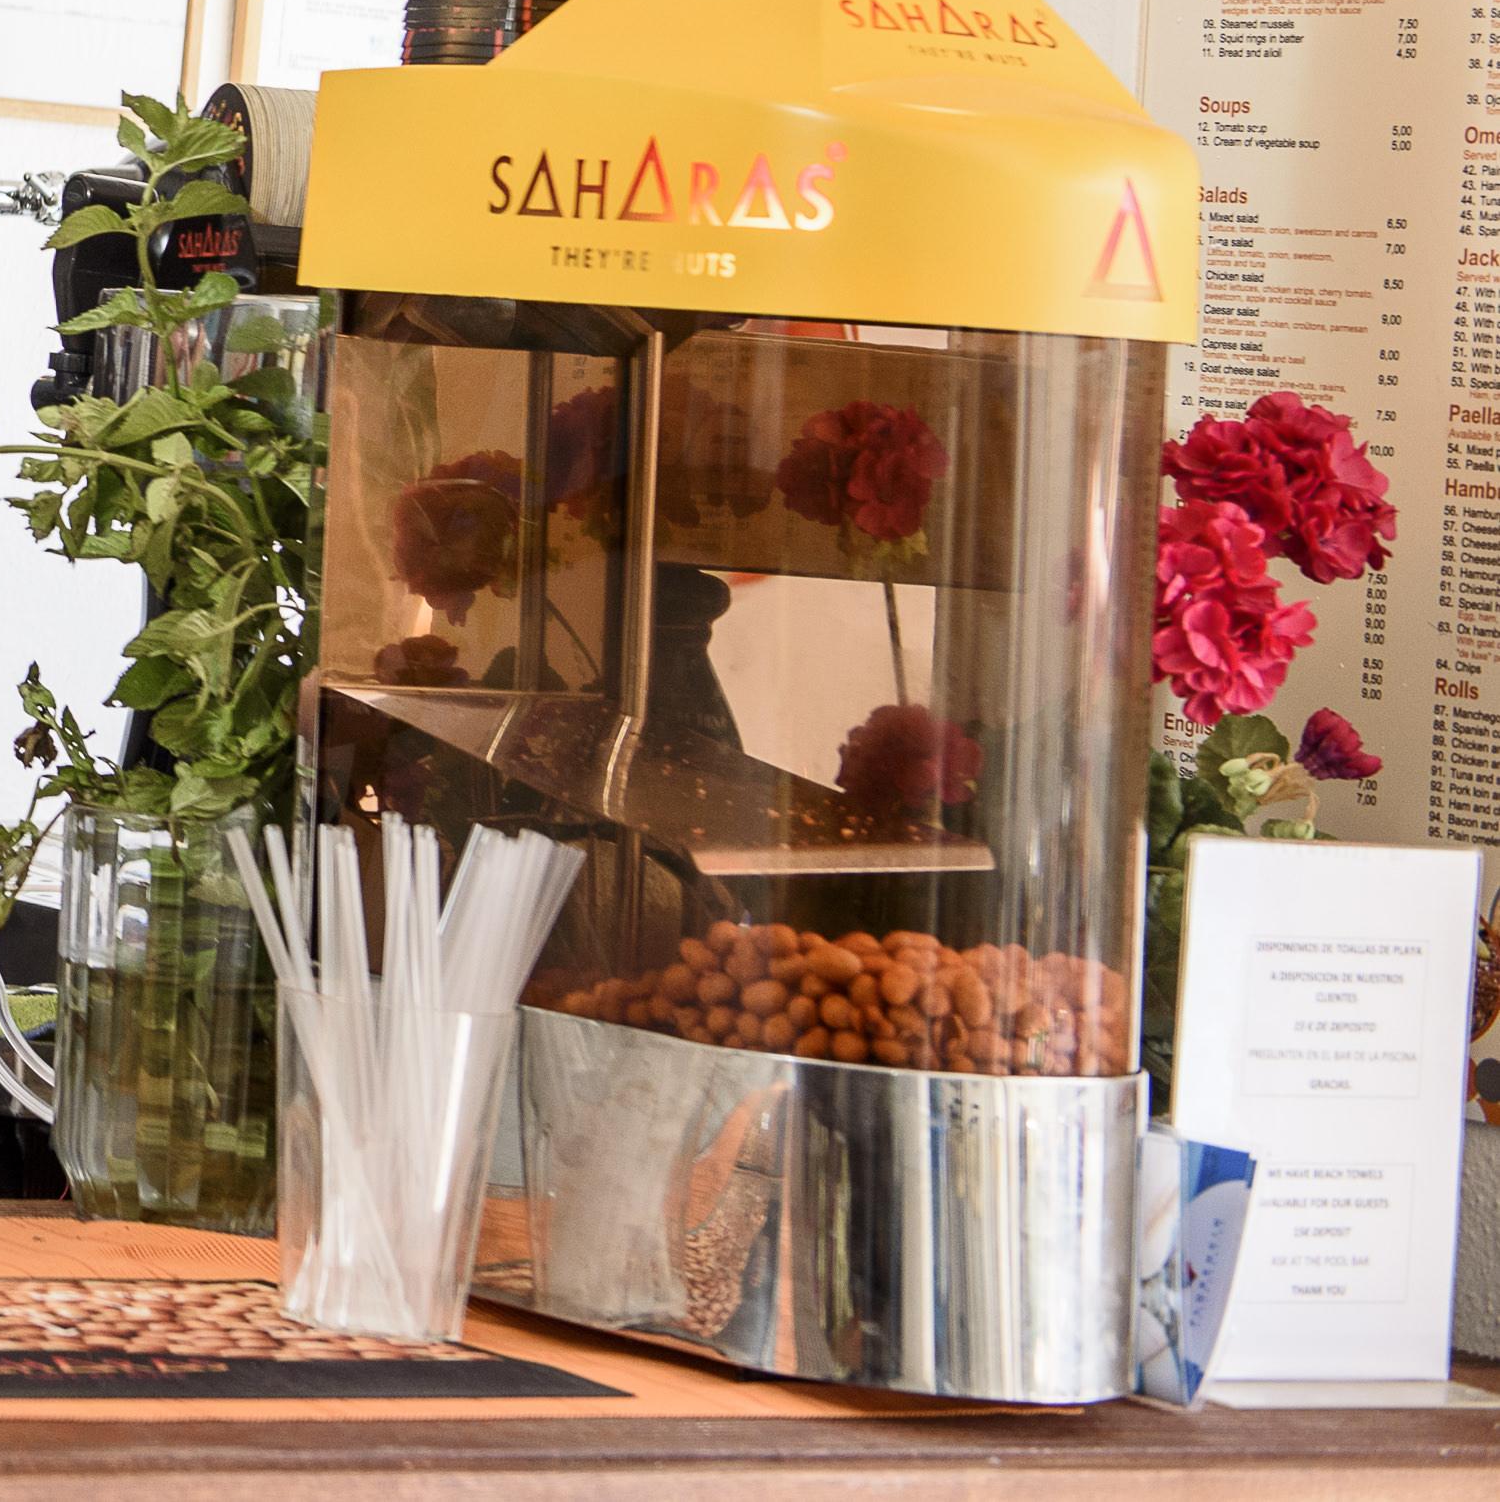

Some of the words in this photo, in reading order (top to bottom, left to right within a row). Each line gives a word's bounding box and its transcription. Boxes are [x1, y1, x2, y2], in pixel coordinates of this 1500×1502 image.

[1218, 47, 1243, 58] Bread
[1396, 48, 1416, 59] 4,50
[1200, 95, 1250, 117] Soups
[1214, 122, 1245, 133] Tomato
[1391, 125, 1412, 137] 5,00
[1213, 136, 1242, 148] Cream
[1254, 137, 1296, 150] vegetable
[1298, 139, 1320, 150] soup
[1391, 140, 1412, 152] 5,00
[489, 135, 837, 232] SAHARAS
[1197, 185, 1249, 204] Salads
[1209, 211, 1234, 223] Mixed
[1236, 213, 1260, 224] salad
[550, 245, 652, 273] THEY'RE
[1205, 270, 1240, 283] Chicken
[1241, 272, 1264, 283] salad
[1200, 362, 1222, 375] Goat
[1223, 364, 1255, 376] cheese
[1256, 366, 1280, 378] salad
[1465, 459, 1496, 473] Paella
[1455, 661, 1482, 675] Chips
[1434, 677, 1480, 700] Rolls
[1451, 737, 1490, 754] Chicken
[1449, 782, 1471, 798] Pork
[1447, 813, 1478, 829] Bacon
[1480, 816, 1500, 832] and
